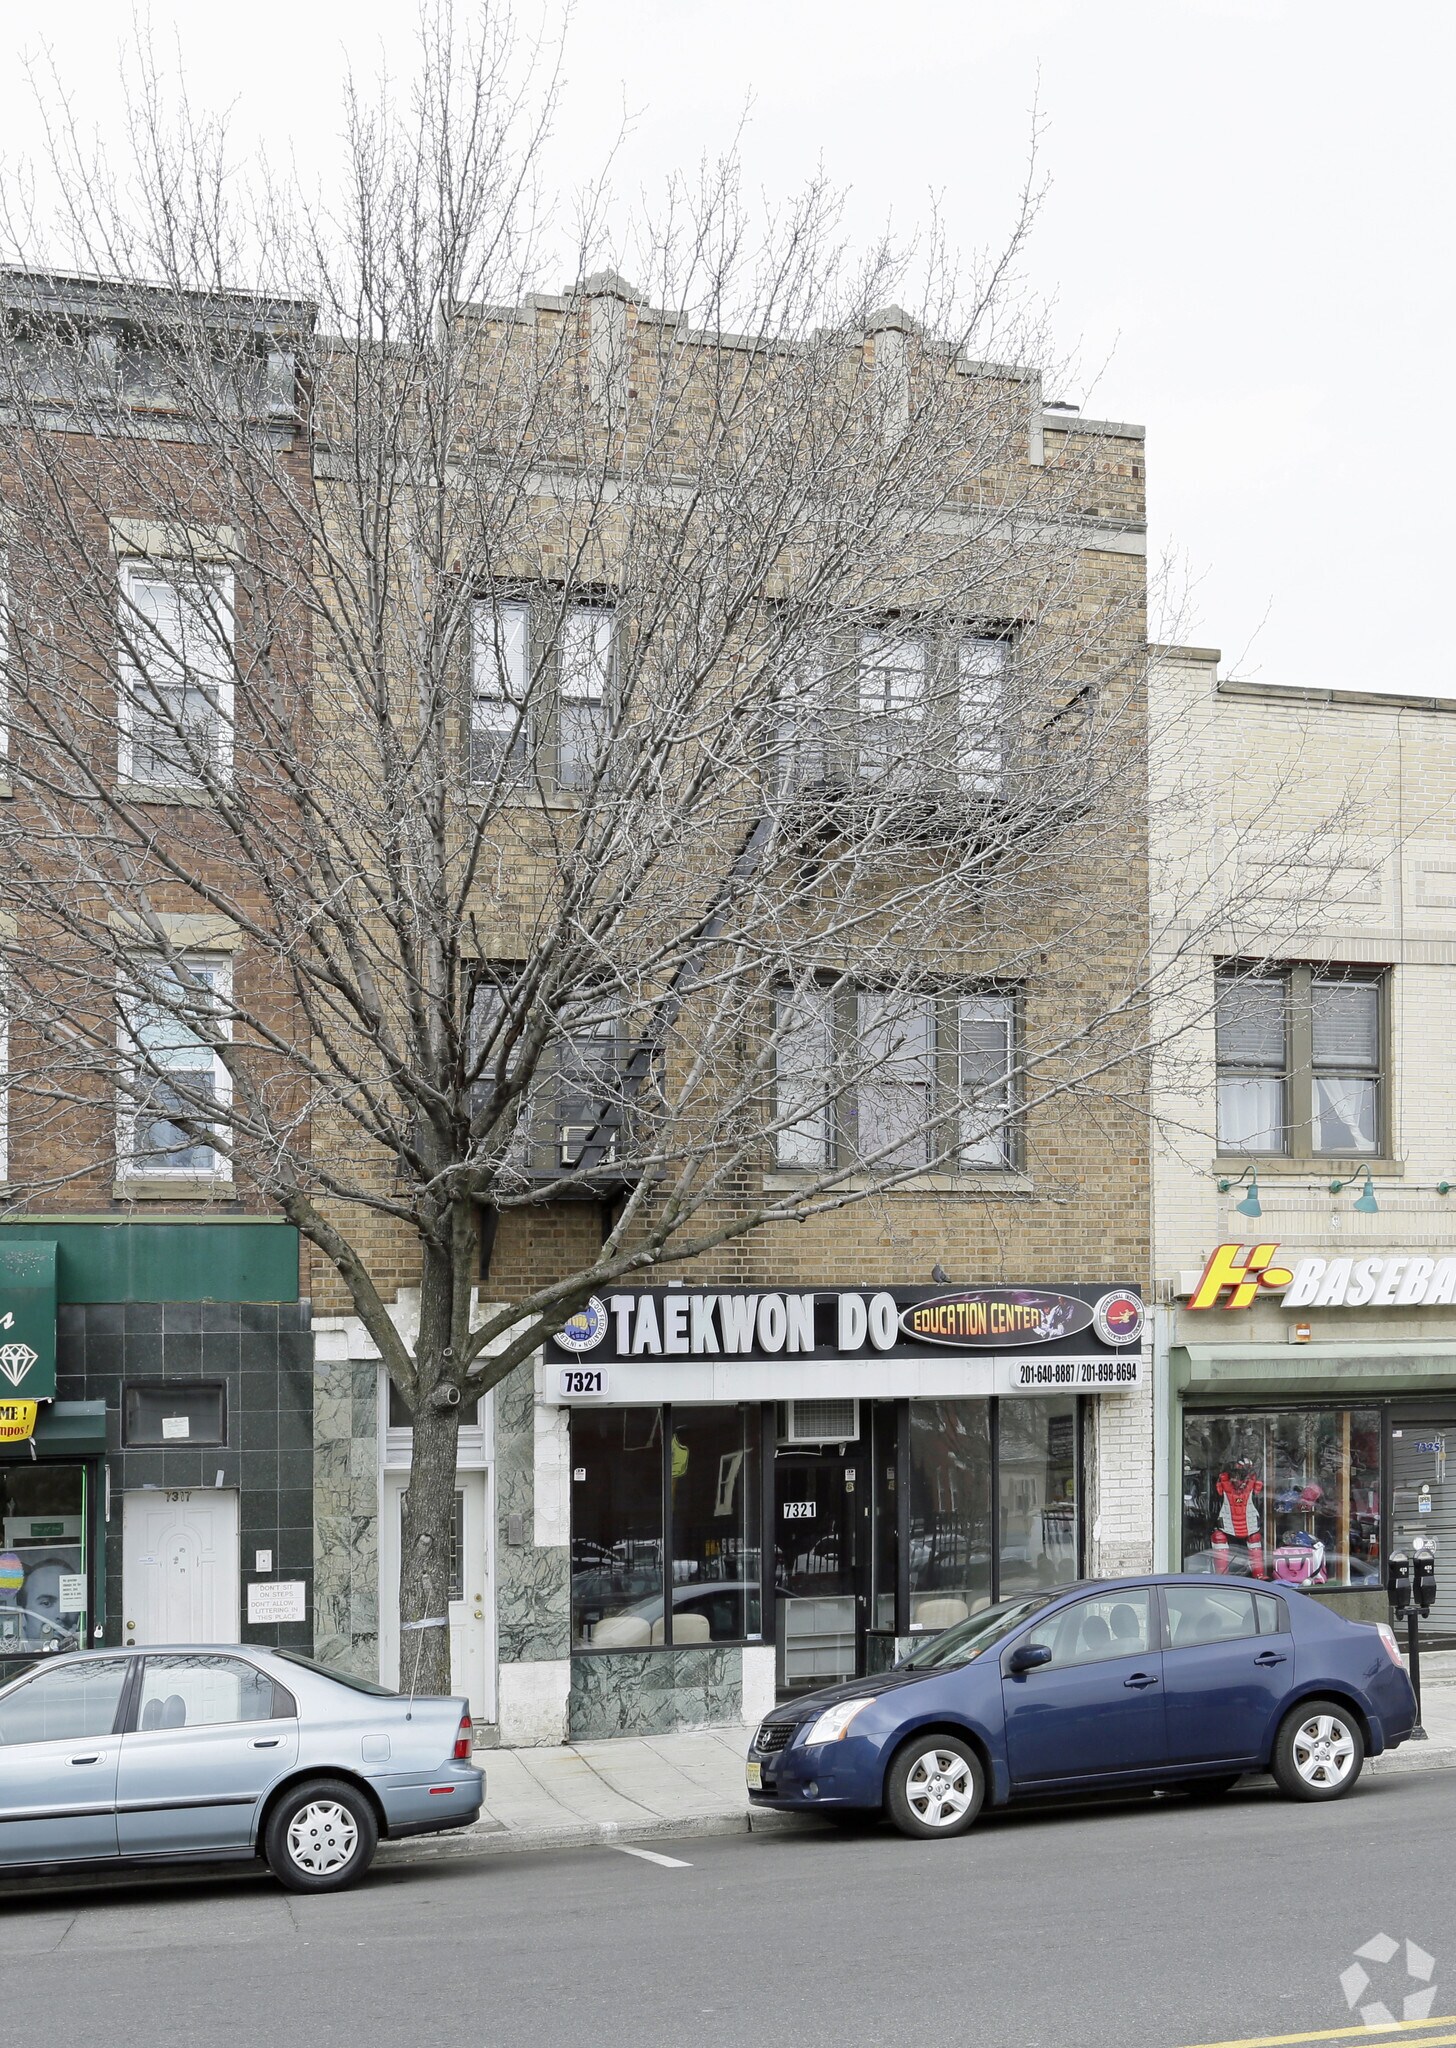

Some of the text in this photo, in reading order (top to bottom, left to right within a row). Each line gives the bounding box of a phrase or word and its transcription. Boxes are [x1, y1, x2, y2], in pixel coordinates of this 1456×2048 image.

[611, 1292, 898, 1354] TAEKWON DO
[914, 1303, 1039, 1335] EDUCATION CENTER
[565, 1372, 601, 1392] 7321
[1021, 1365, 1075, 1383] 201-640-8887
[1082, 1363, 1136, 1382] 201-898-8694
[1414, 1442, 1440, 1453] 7325
[785, 1503, 815, 1517] 7321
